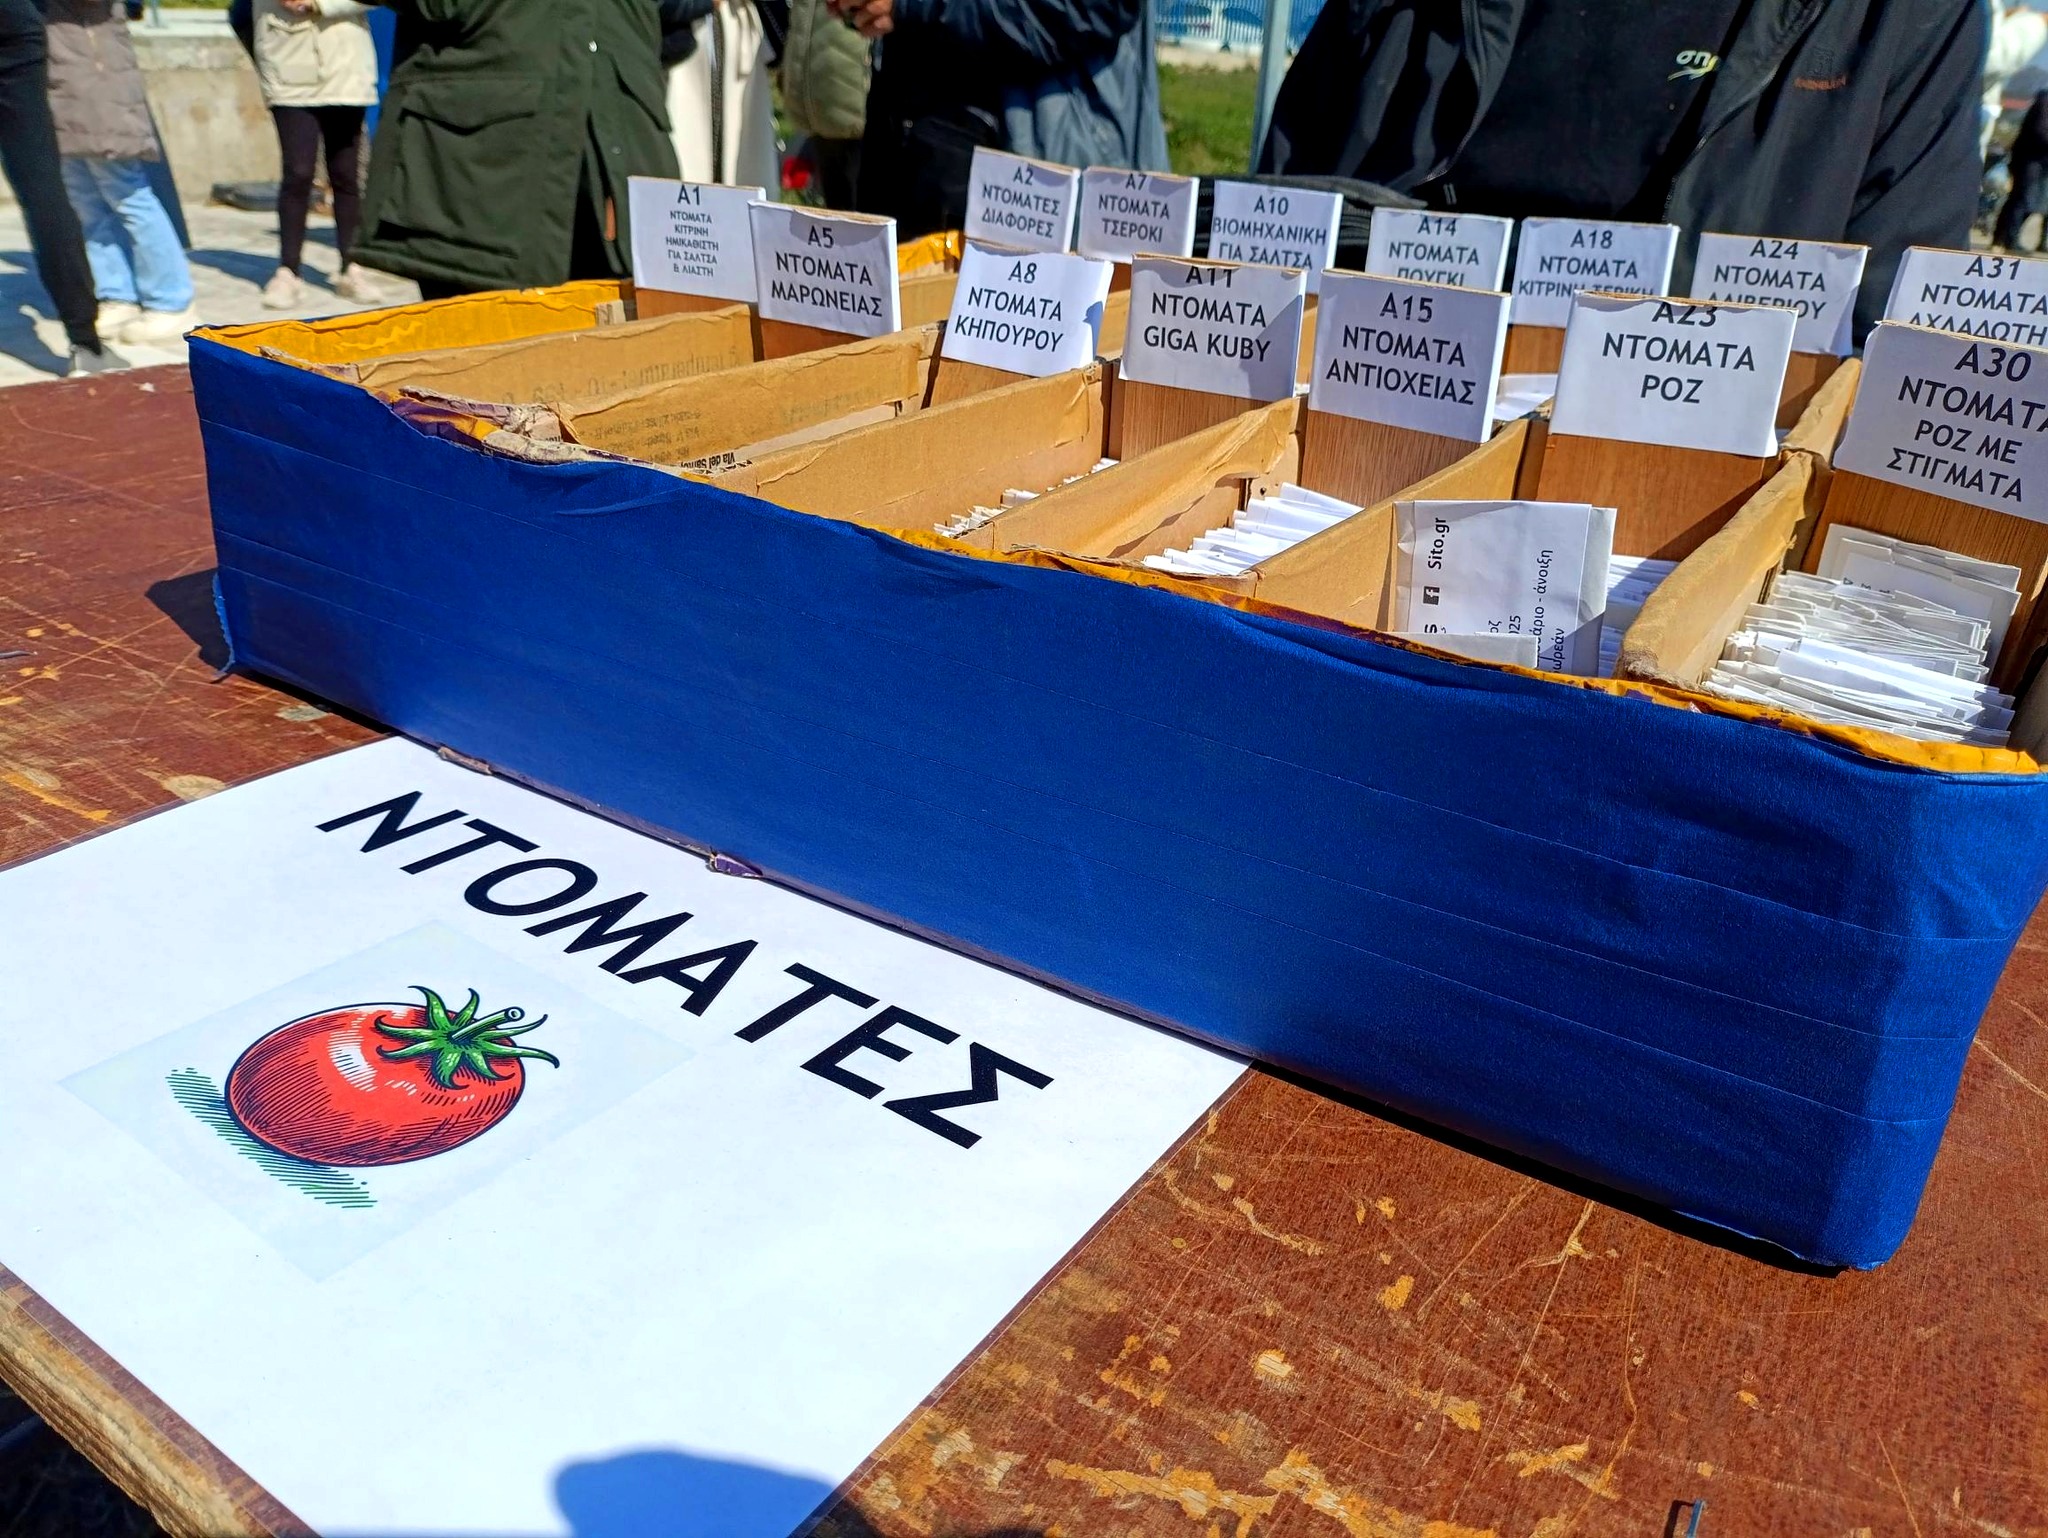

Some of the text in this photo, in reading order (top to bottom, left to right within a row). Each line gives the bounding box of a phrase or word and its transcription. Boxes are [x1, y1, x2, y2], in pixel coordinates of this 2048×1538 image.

[1013, 166, 1034, 186] Α2
[1125, 173, 1147, 192] Α7
[677, 184, 700, 206] Α1
[982, 184, 1060, 216] ΝΤΟΜΑΤΕΣ
[1098, 194, 1170, 220] ΝΤΟΜΑΤΑ
[1254, 195, 1289, 216] Α10
[670, 210, 712, 224] ΝΤΟΜΑΤΑ
[674, 224, 709, 237] ΚΙΤΡΙΝΗ
[981, 207, 1055, 239] ΔΙΑΦΟΡΕΣ
[1102, 218, 1163, 243] ΤΣΕΡΟΚΙ
[1417, 215, 1457, 236] Α14
[665, 236, 719, 251] ΗΜΙΚΑΘΙΣΤΗ
[807, 224, 835, 249] Α5
[1212, 217, 1327, 246] ΒΙΟΜΗΧΑΝΙΚΗ
[1570, 228, 1613, 249] Α18
[668, 249, 717, 265] ΓΙΑ ΣΑΛΤΣΑ
[1219, 242, 1313, 270] ΓΙΑ ΣΑΛΤΣΑ
[1388, 241, 1479, 265] ΝΤΟΜΑΤΑ
[1749, 238, 1799, 261] Α24
[682, 265, 714, 277] ΛΙΑΣΤΗ
[775, 251, 873, 287] ΝΤΟΜΑΤΑ
[1007, 260, 1038, 284] Α8
[1185, 265, 1232, 288] Α11
[1538, 255, 1638, 279] ΝΤΟΜΑΤΑ
[1713, 264, 1826, 292] ΝΤΟΜΑΤΑ
[1964, 255, 2021, 280] Α31
[771, 280, 882, 318] ΜΑΡΩΝΕΙΑΣ
[967, 286, 1062, 321] ΝΤΟΜΑΤΑ
[1151, 292, 1267, 328] ΝΤΟΜΑΤΑ
[1379, 292, 1434, 324] Α15
[1921, 283, 2048, 316] ΝΤΟΜΑΤΑ
[954, 314, 1064, 353] ΚΗΠΟΥΡΟΥ
[1143, 325, 1271, 362] GIGA KUBY
[1342, 324, 1466, 368] ΝΤΟΜΑΤΑ
[1602, 332, 1755, 372] ΝΤΟΜΑΤΑ
[1954, 343, 2032, 382] Α30
[1325, 358, 1477, 405] ΑΝΤΙΟΧΕΙΑΣ
[1640, 373, 1704, 404] ΡΟΖ
[1914, 419, 2023, 466] ΡΟΖ ΜΕ
[1886, 447, 2023, 503] ΣΤΙΓΜΑΤΑ
[1427, 517, 1450, 570] Sito.gr
[1533, 549, 1554, 595] άνοιξη
[1552, 627, 1566, 673] ωρεάν
[315, 790, 1056, 1151] ΝΤΟΜΑΤΕΣ
